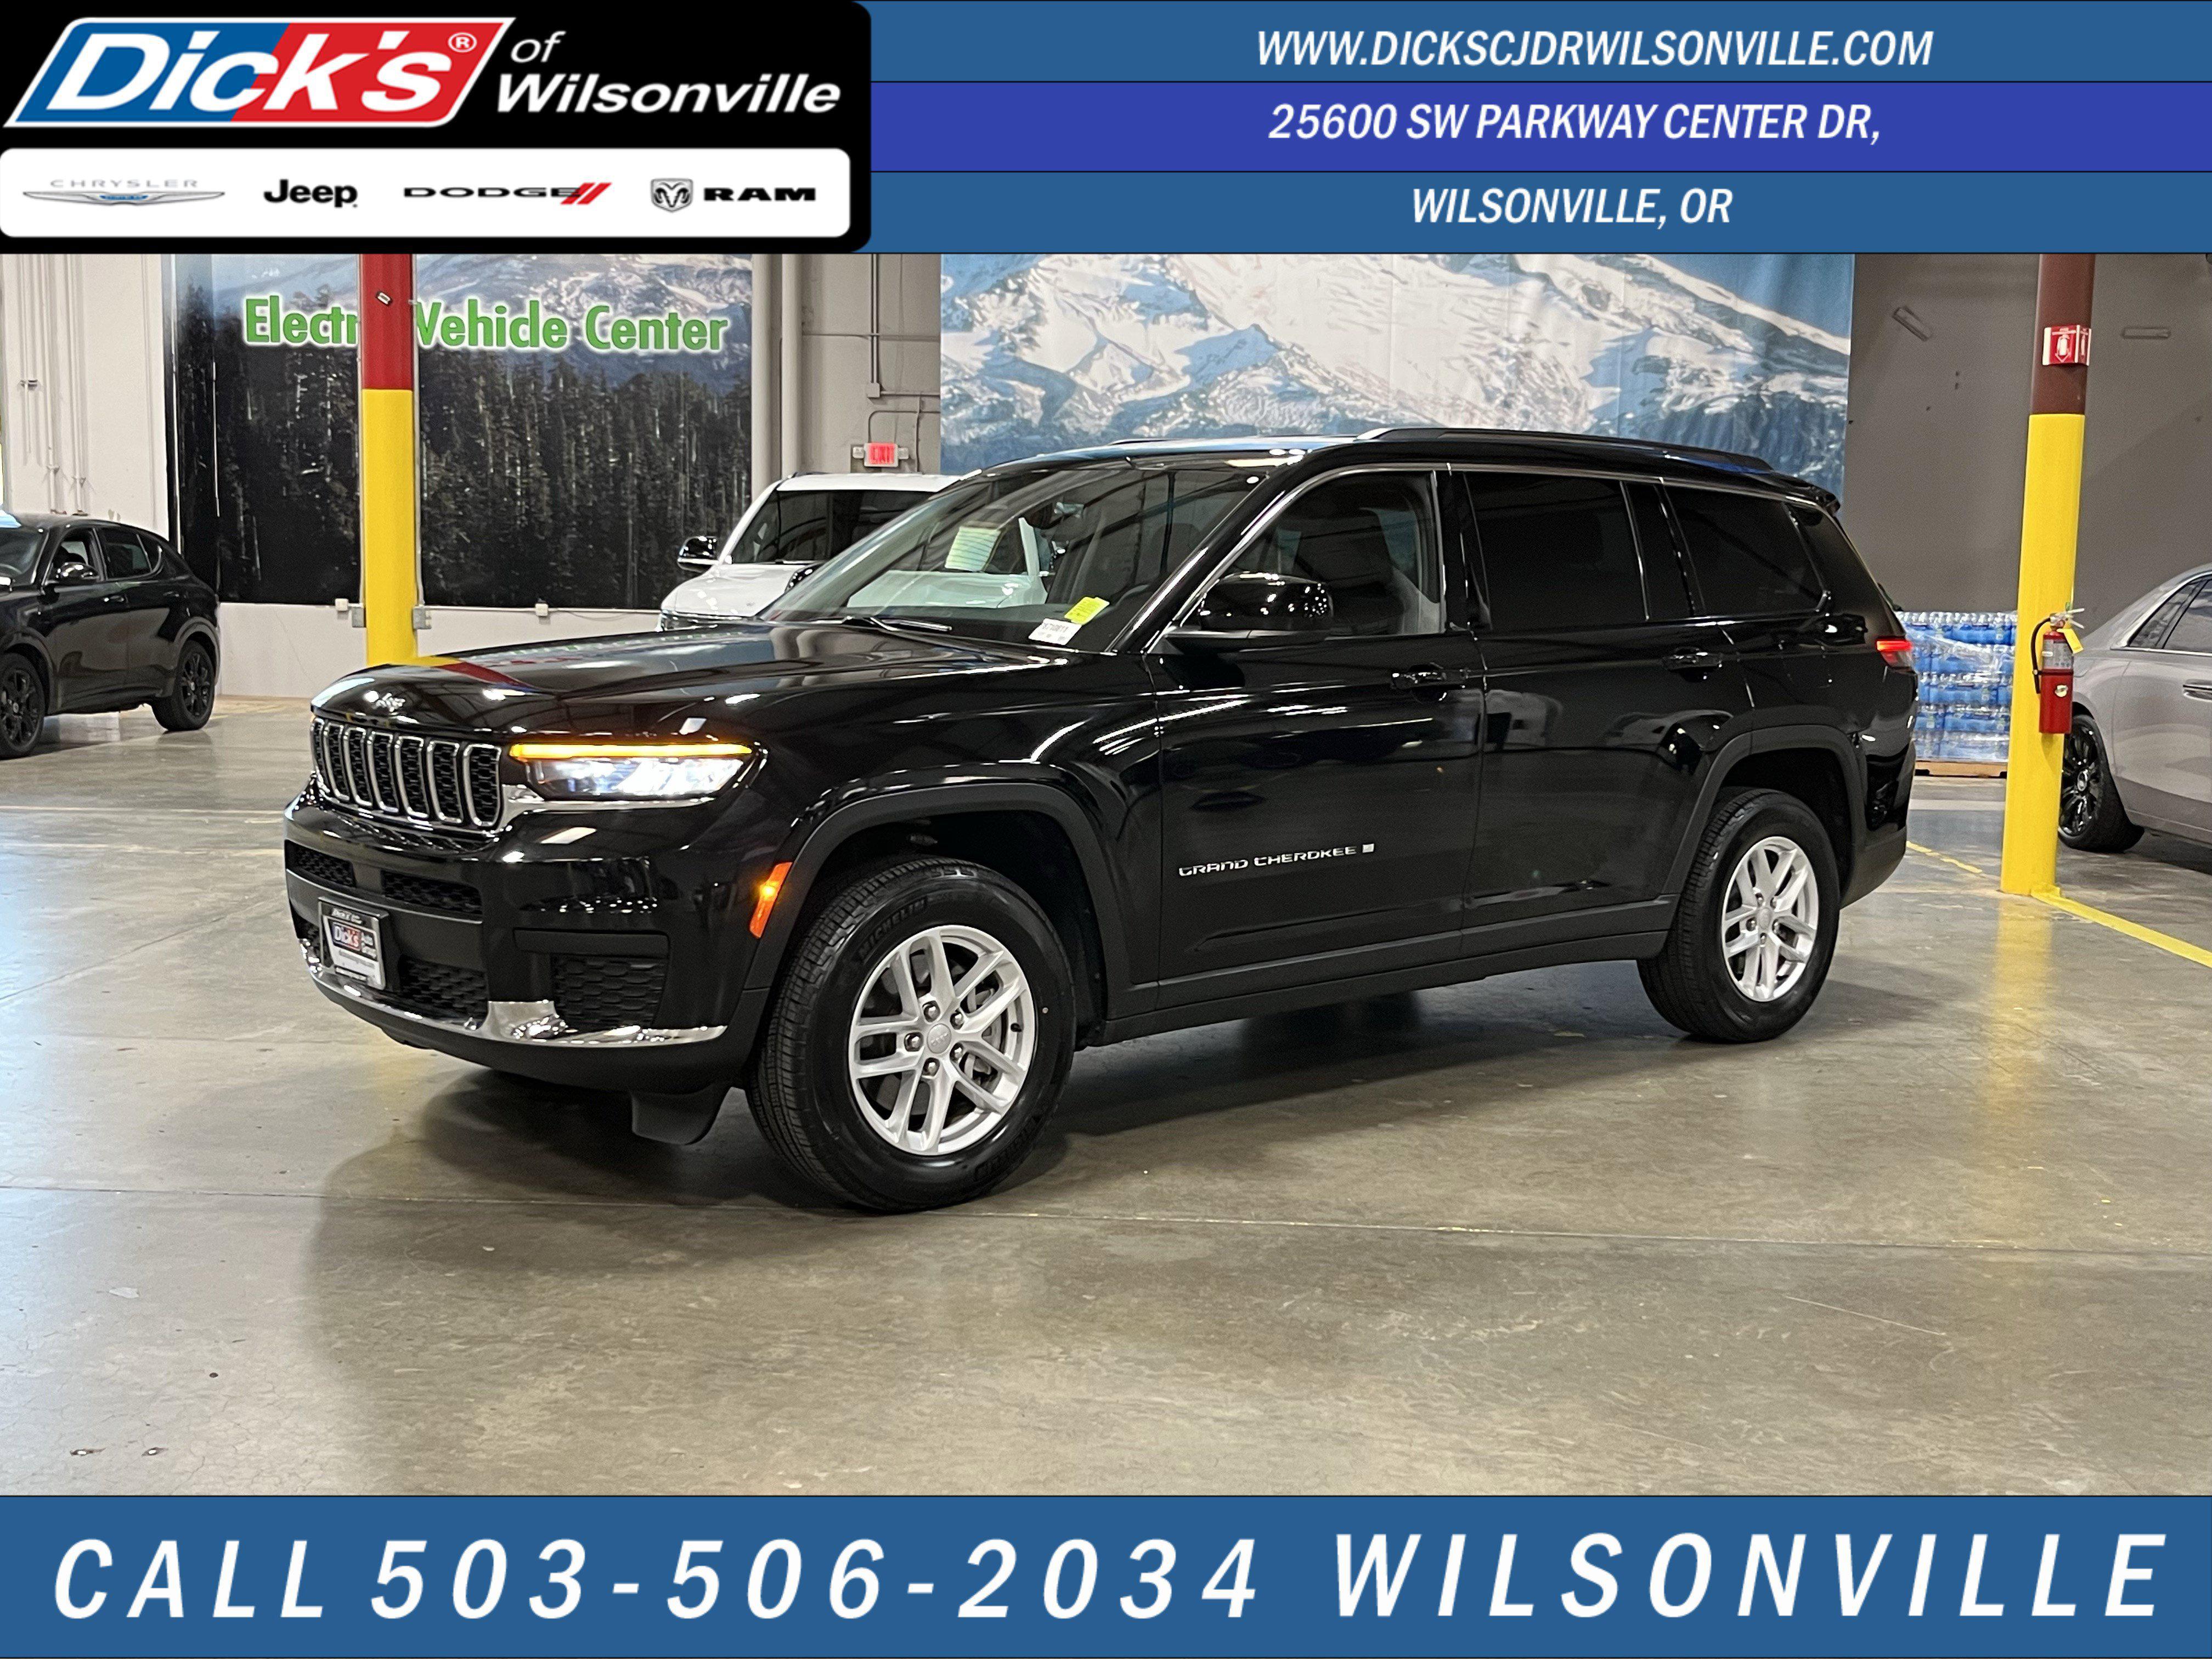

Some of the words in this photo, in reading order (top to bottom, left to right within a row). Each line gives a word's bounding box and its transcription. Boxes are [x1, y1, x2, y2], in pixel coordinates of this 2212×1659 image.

[246, 295, 357, 344] Electr
[417, 298, 567, 348] Vehicle
[585, 305, 729, 350] Center
[1178, 859, 1249, 877] GRAND
[1254, 846, 1357, 867] CHEROKEE
